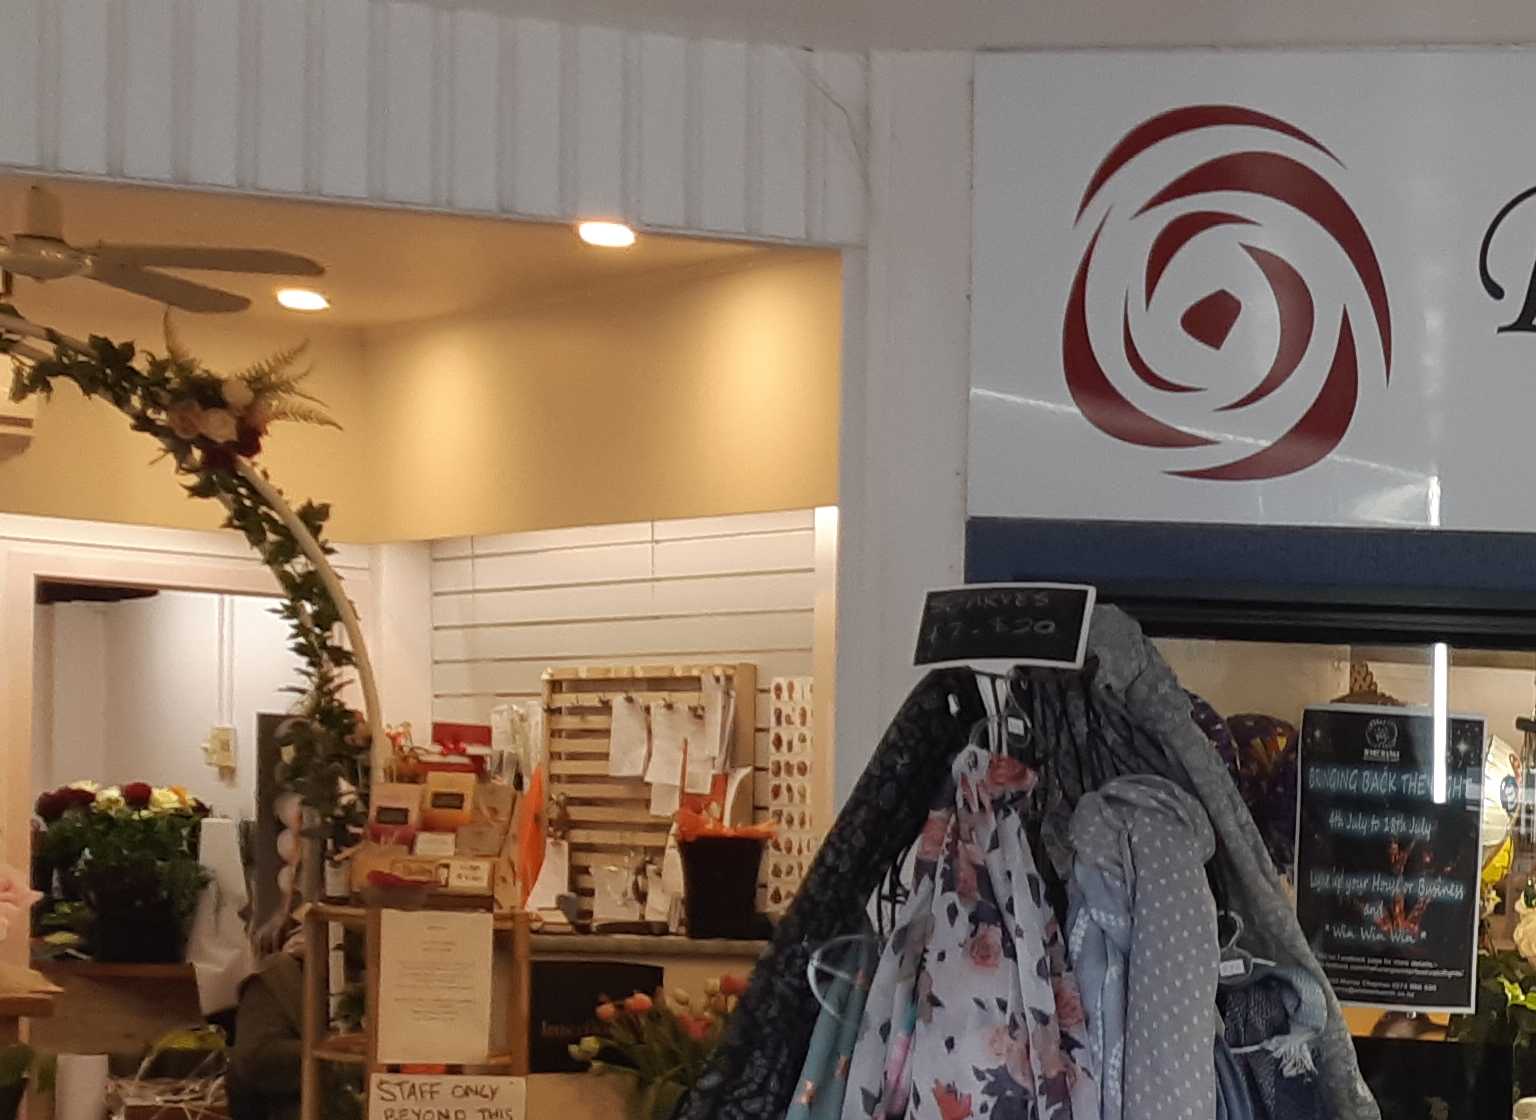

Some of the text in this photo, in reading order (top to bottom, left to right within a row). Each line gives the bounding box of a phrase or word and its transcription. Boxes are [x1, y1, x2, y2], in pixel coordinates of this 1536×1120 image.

[1361, 769, 1398, 795] BACK
[1401, 772, 1426, 796] THE
[1346, 812, 1368, 835] July
[1408, 816, 1432, 842] July
[1417, 876, 1466, 901] Business
[377, 1078, 500, 1102] STAFF ONLY
